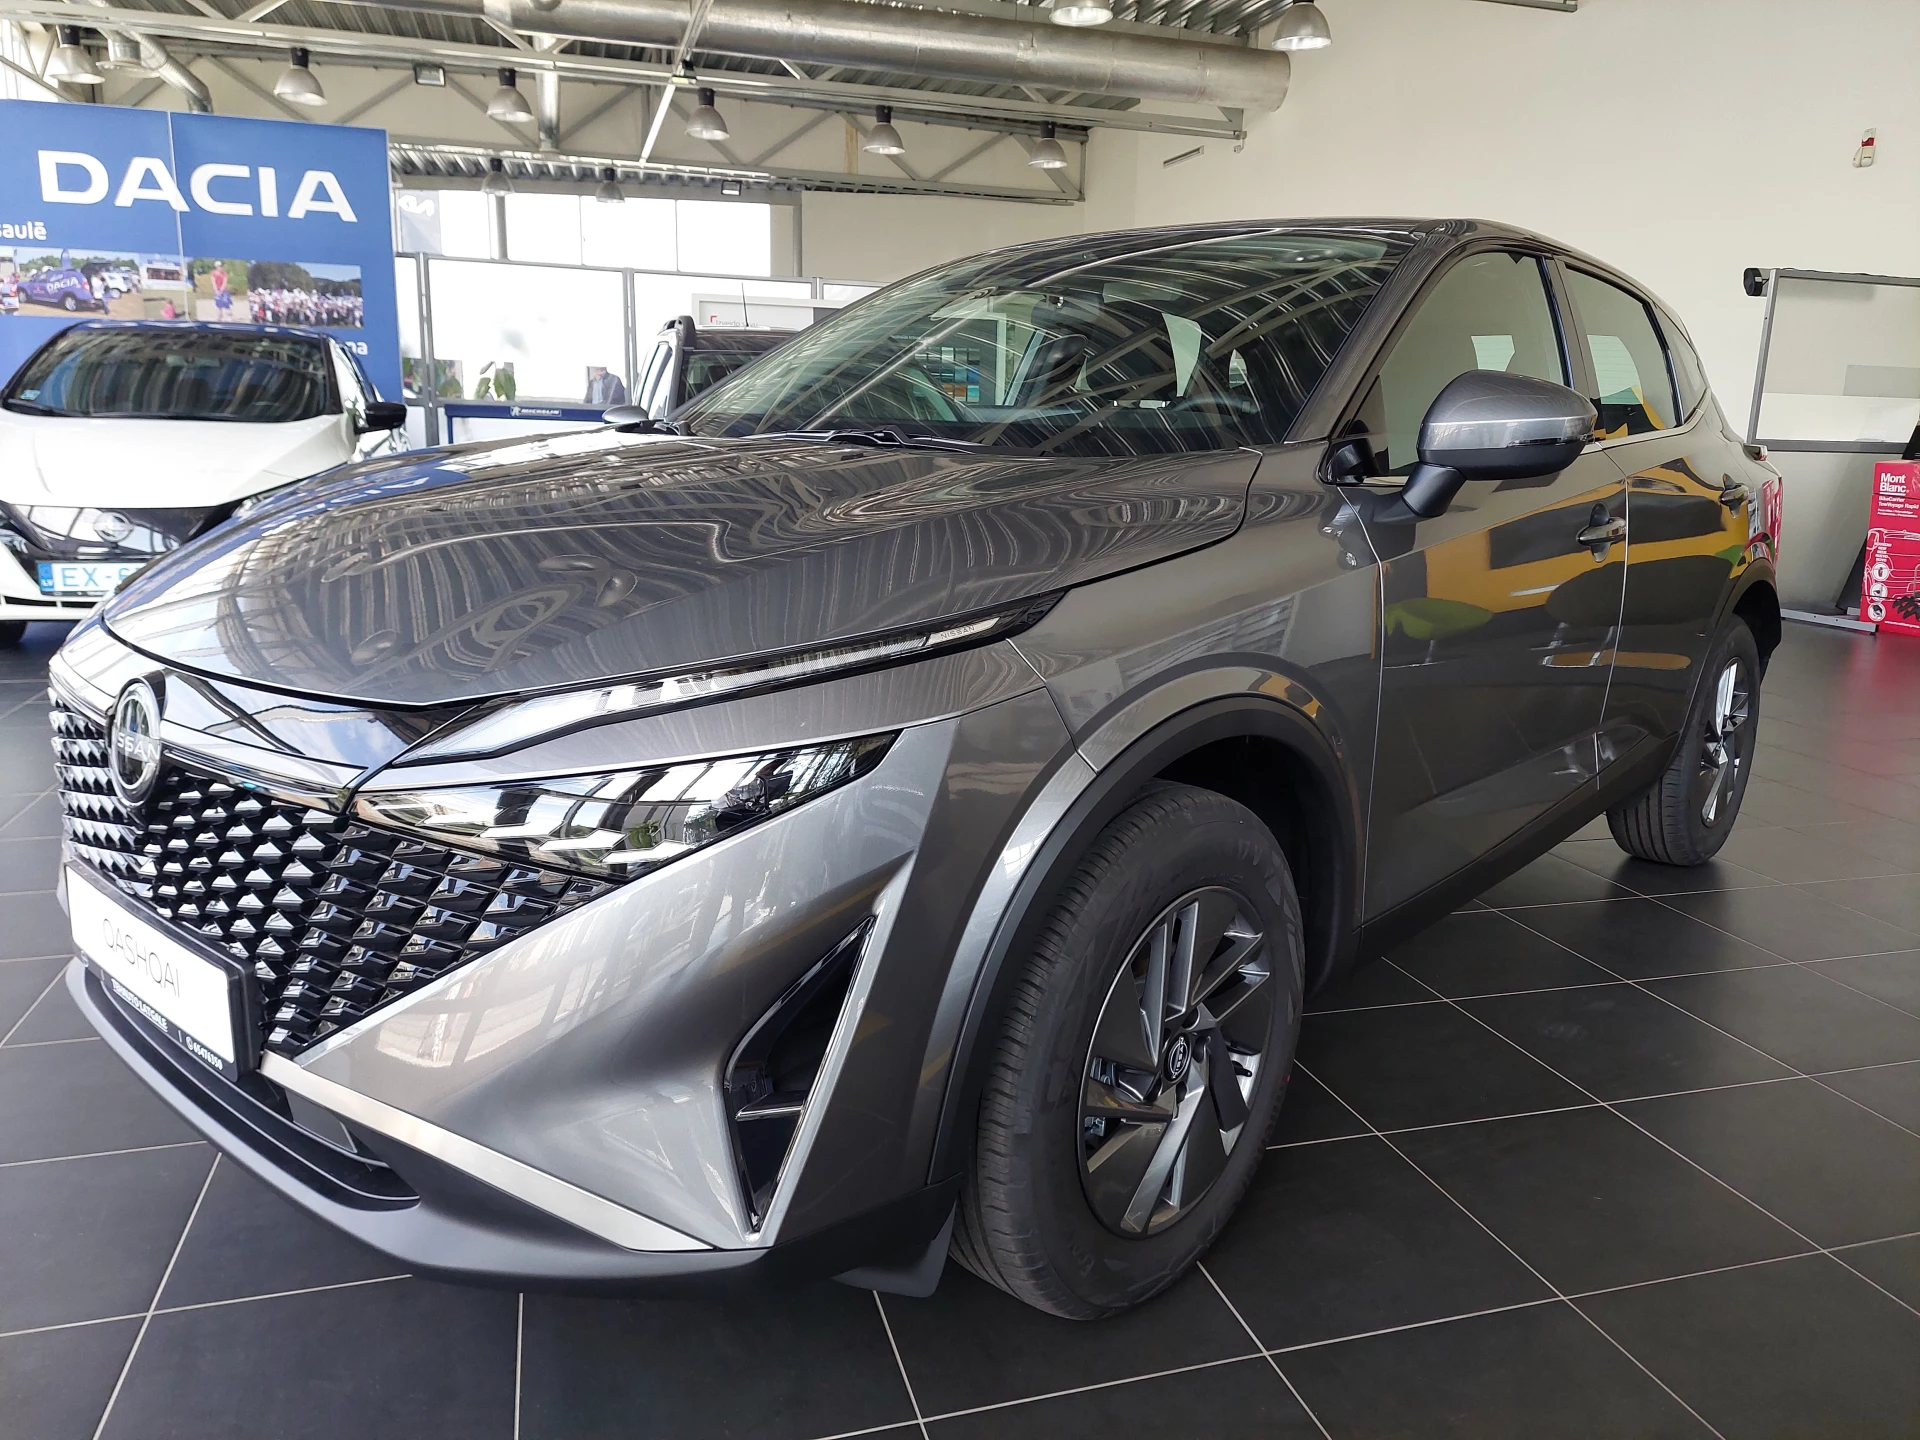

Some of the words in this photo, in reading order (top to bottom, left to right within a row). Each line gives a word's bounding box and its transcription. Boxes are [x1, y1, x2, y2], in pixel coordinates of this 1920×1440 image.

[38, 150, 358, 222] DACIA
[0, 221, 47, 240] aulē
[1880, 472, 1906, 483] Mont
[1879, 482, 1907, 493] Blanc
[941, 625, 976, 639] NISSAN
[103, 918, 180, 998] QASHQAI
